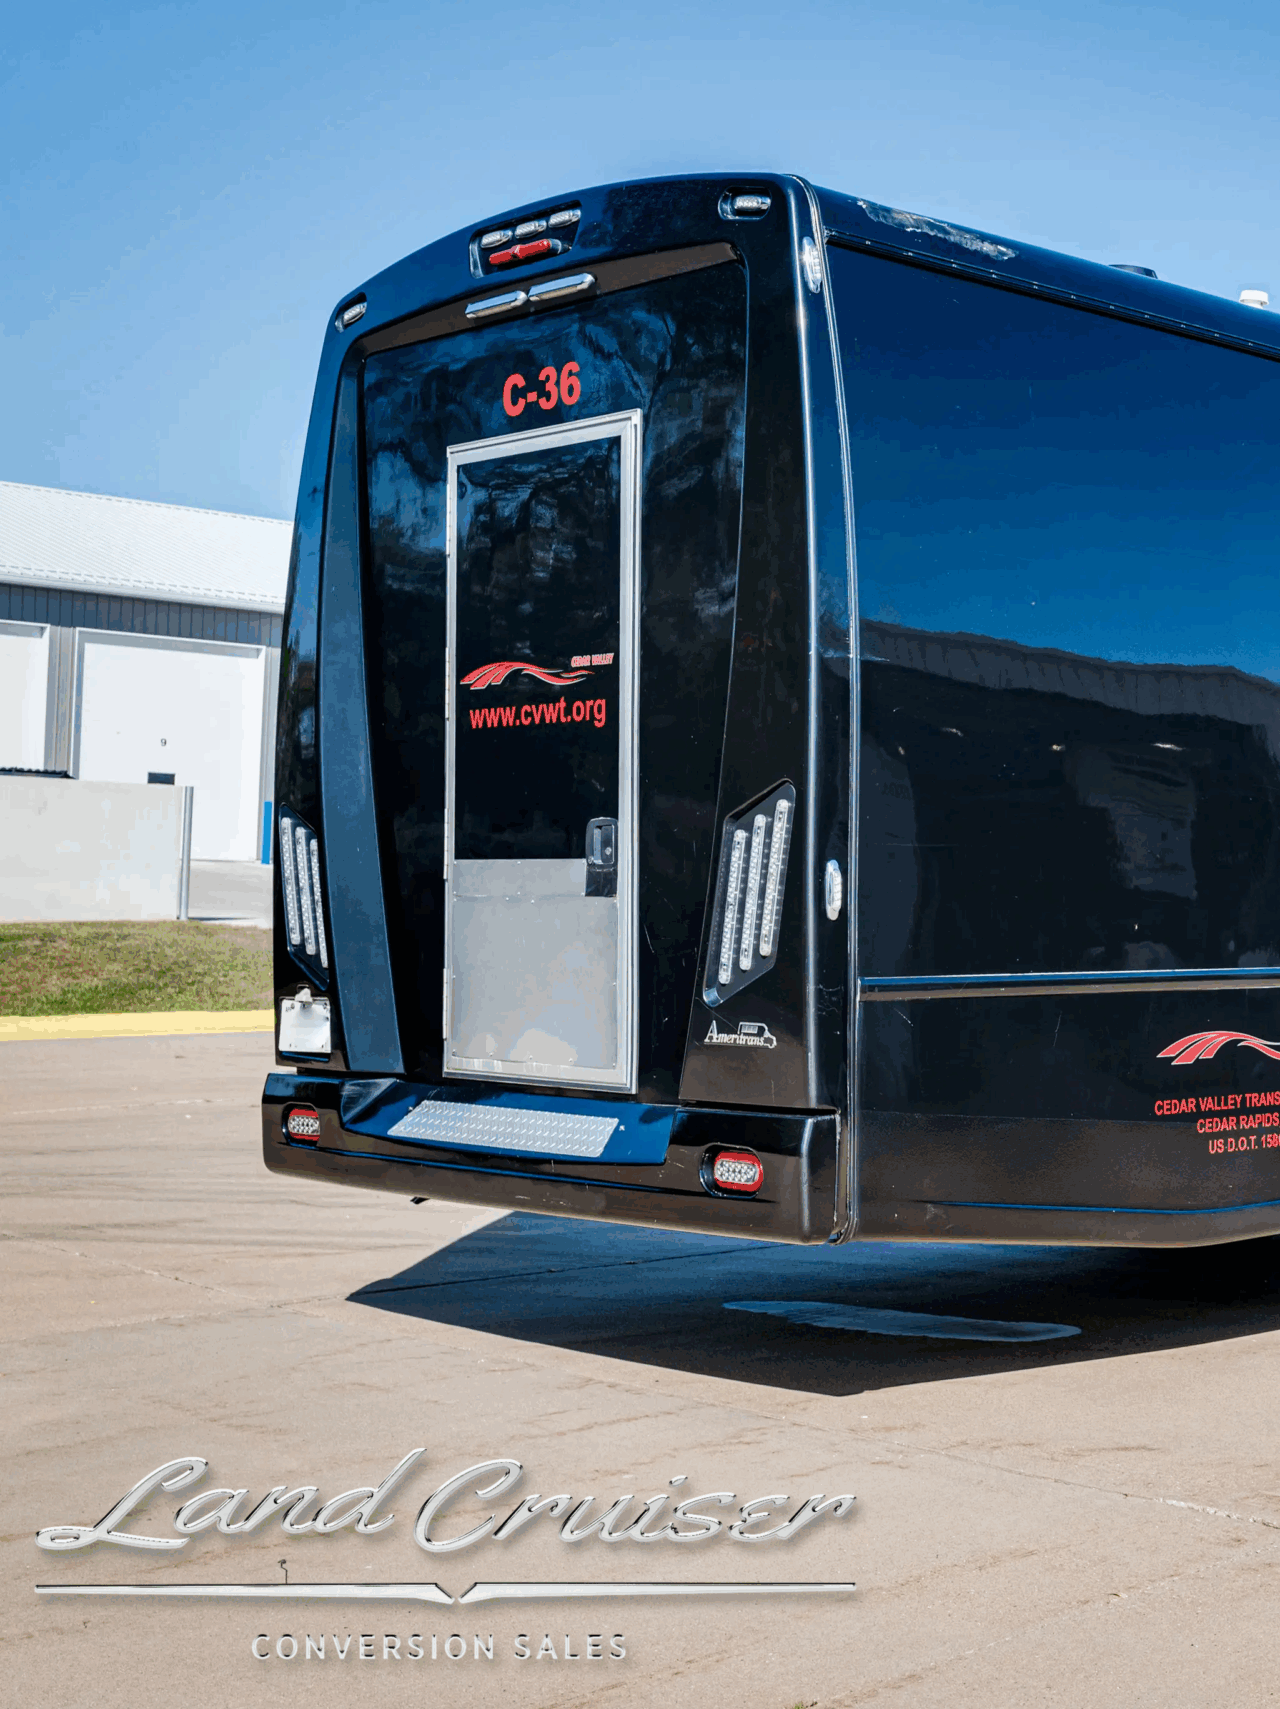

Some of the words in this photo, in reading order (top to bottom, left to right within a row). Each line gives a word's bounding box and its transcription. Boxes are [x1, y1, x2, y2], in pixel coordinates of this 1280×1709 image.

[502, 361, 581, 417] C-36
[469, 696, 606, 729] www.cvwt.org
[1154, 1098, 1197, 1116] CEDAR
[1198, 1094, 1243, 1112] VALLEY
[1196, 1116, 1237, 1134] CEDAR
[1208, 1138, 1225, 1155] US
[1227, 1135, 1259, 1152] D.O.T.
